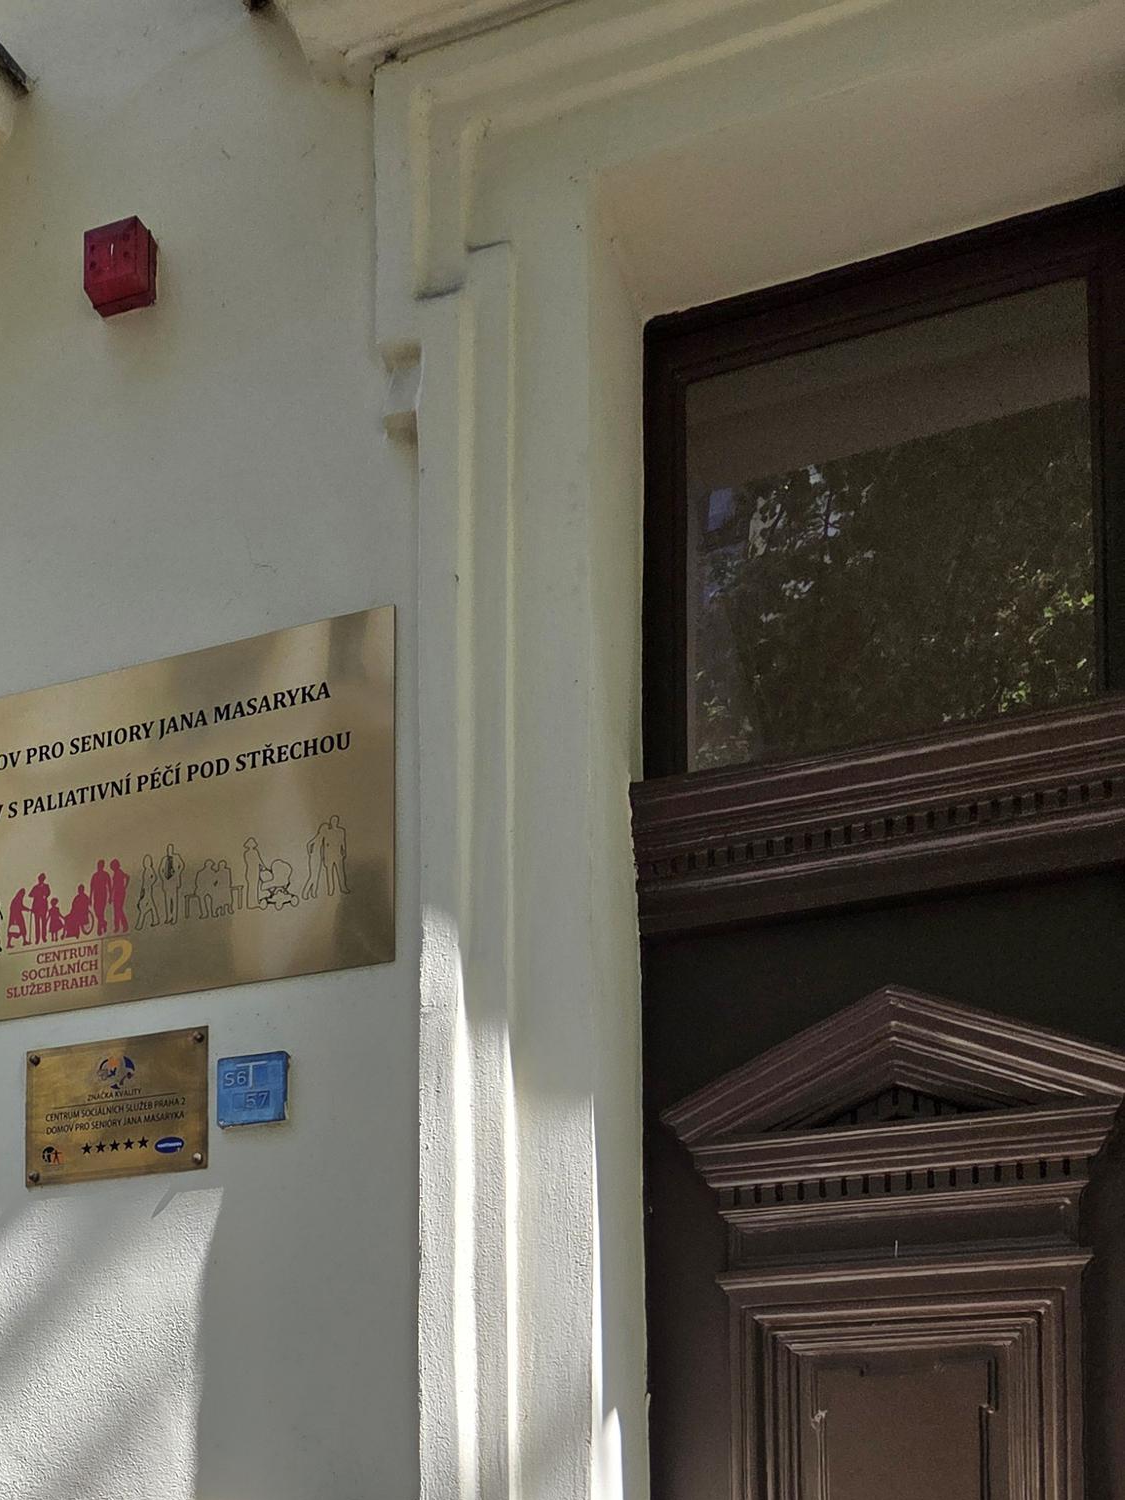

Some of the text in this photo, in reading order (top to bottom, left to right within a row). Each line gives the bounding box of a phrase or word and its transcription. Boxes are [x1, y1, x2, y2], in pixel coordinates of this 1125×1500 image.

[26, 742, 64, 765] PRO
[69, 721, 155, 755] SENIORY
[159, 710, 208, 740] JANA
[213, 681, 332, 724] MASARYKA
[7, 801, 18, 819] S
[22, 772, 132, 816] PALIATIVNÍ
[137, 762, 182, 792] PÉČÍ
[187, 758, 230, 782] POD
[235, 731, 352, 772] STŘECHOU
[36, 943, 98, 965] CENTRUM
[106, 938, 133, 984] 2
[21, 959, 99, 982] SOCIÁLNÍCH
[6, 974, 99, 999] SLUŽEB PRAHA
[114, 1088, 142, 1099] KVALITY
[245, 1092, 268, 1109] 57
[45, 1109, 80, 1122] CENTRUM
[125, 1100, 153, 1113] SLUŽEB
[154, 1097, 180, 1109] PRAHA
[181, 1097, 186, 1105] 2
[46, 1110, 185, 1135] DOMOV PRO SENIORY JANA MASARYKA
